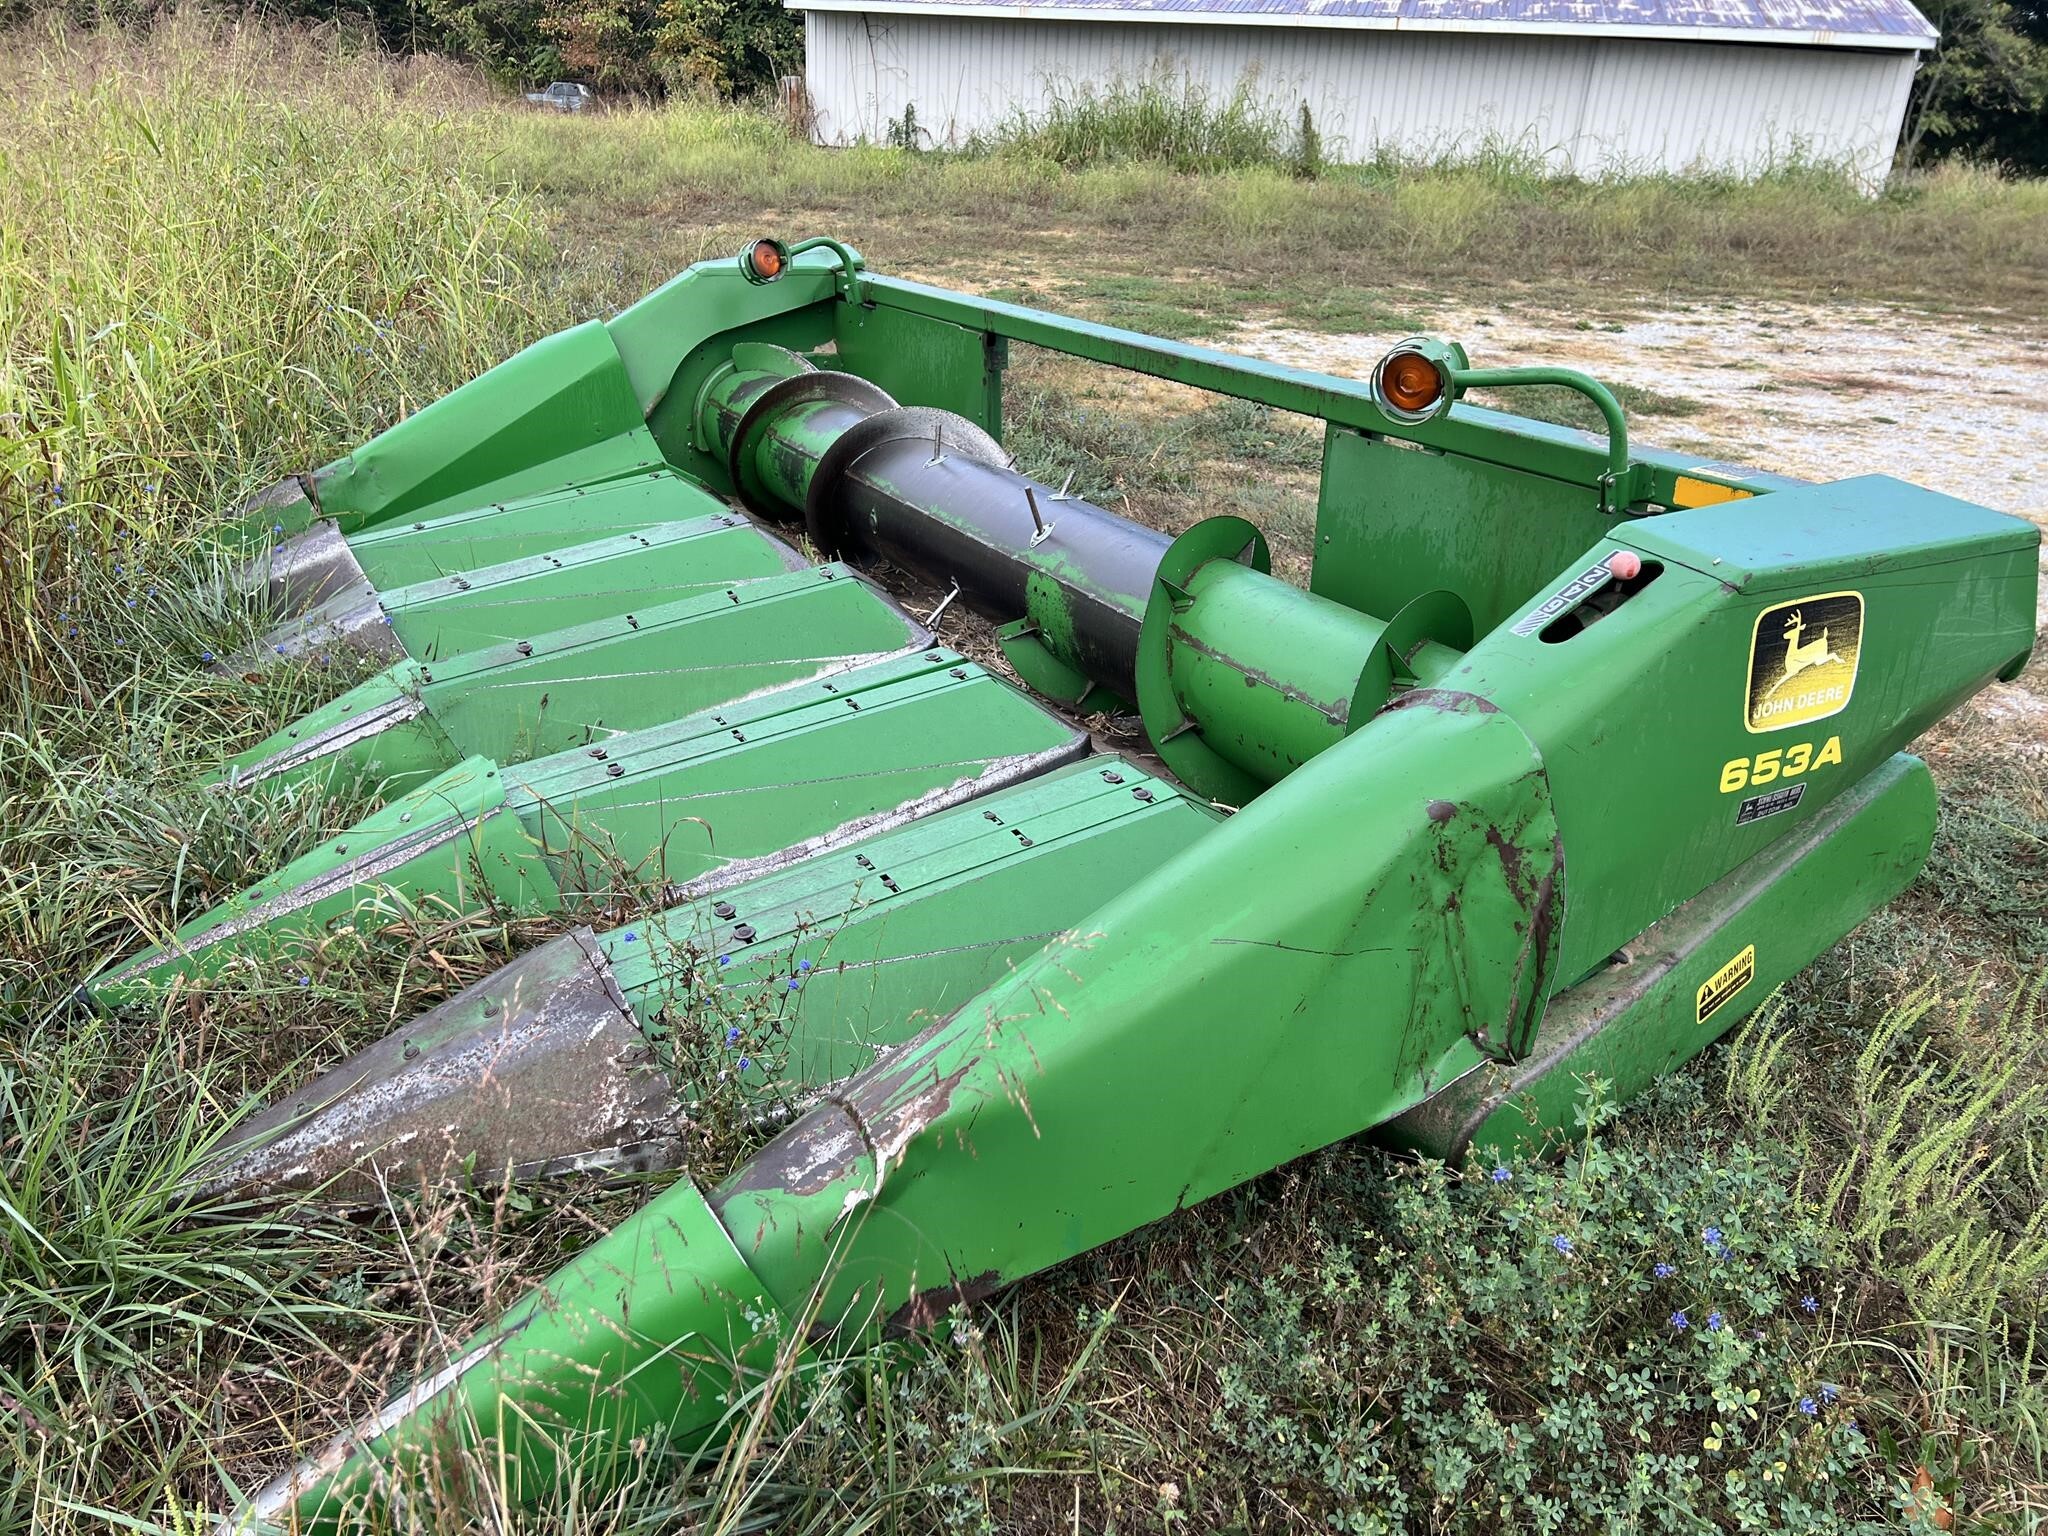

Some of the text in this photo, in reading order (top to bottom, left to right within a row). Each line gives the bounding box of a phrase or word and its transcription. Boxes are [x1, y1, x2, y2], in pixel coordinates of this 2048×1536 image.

[1563, 584, 1585, 597] 4
[1583, 569, 1604, 583] 2
[1753, 686, 1844, 719] JOHN DEERE
[1719, 735, 1842, 794] 653A
[1714, 951, 1752, 991] WARNING
